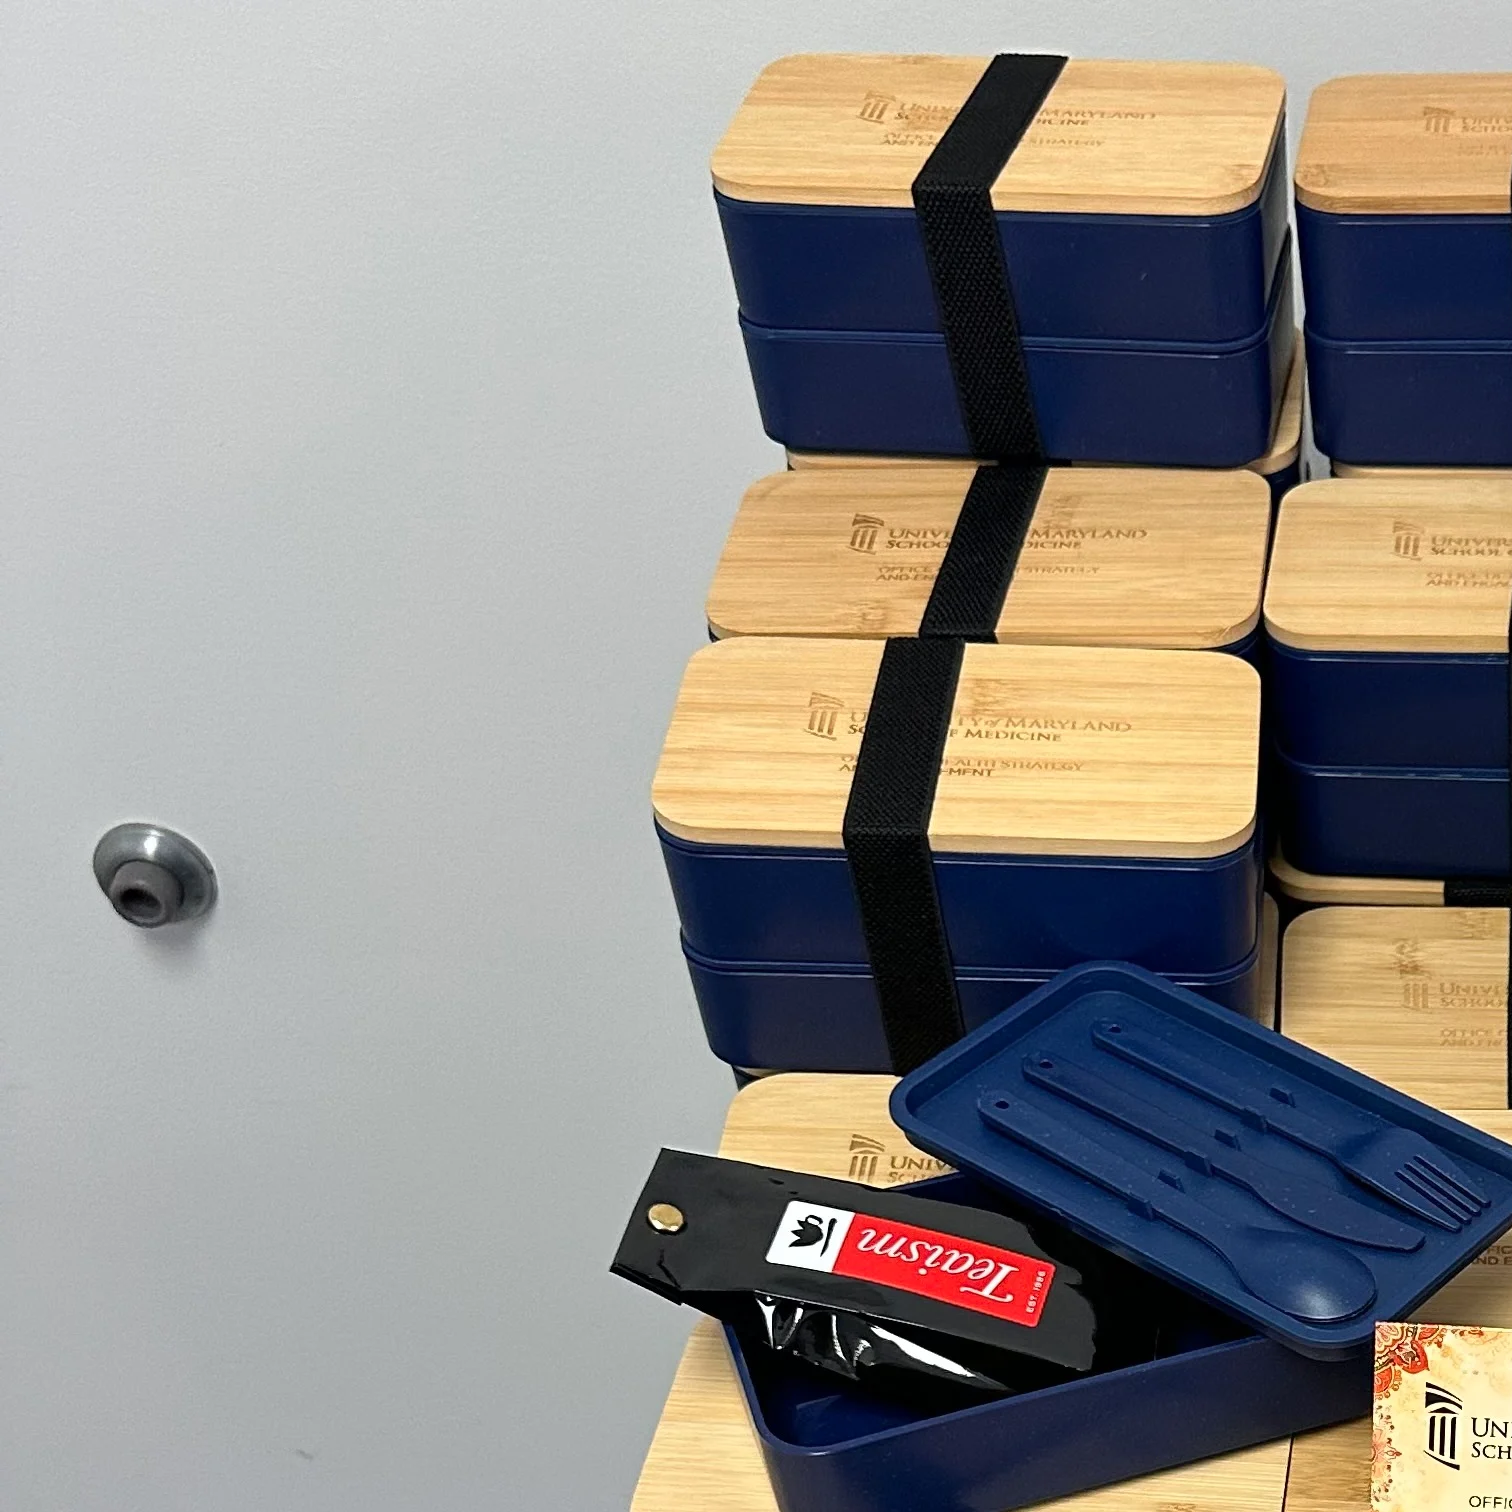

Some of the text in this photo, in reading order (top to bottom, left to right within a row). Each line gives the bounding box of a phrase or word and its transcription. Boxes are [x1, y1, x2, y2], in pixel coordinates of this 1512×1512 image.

[1030, 528, 1148, 540] MARYLAND
[885, 540, 951, 550] SCHOO
[1003, 717, 1132, 732] MARYLAND
[965, 728, 1062, 742] MEDICINE
[857, 1228, 1020, 1303] Teaism
